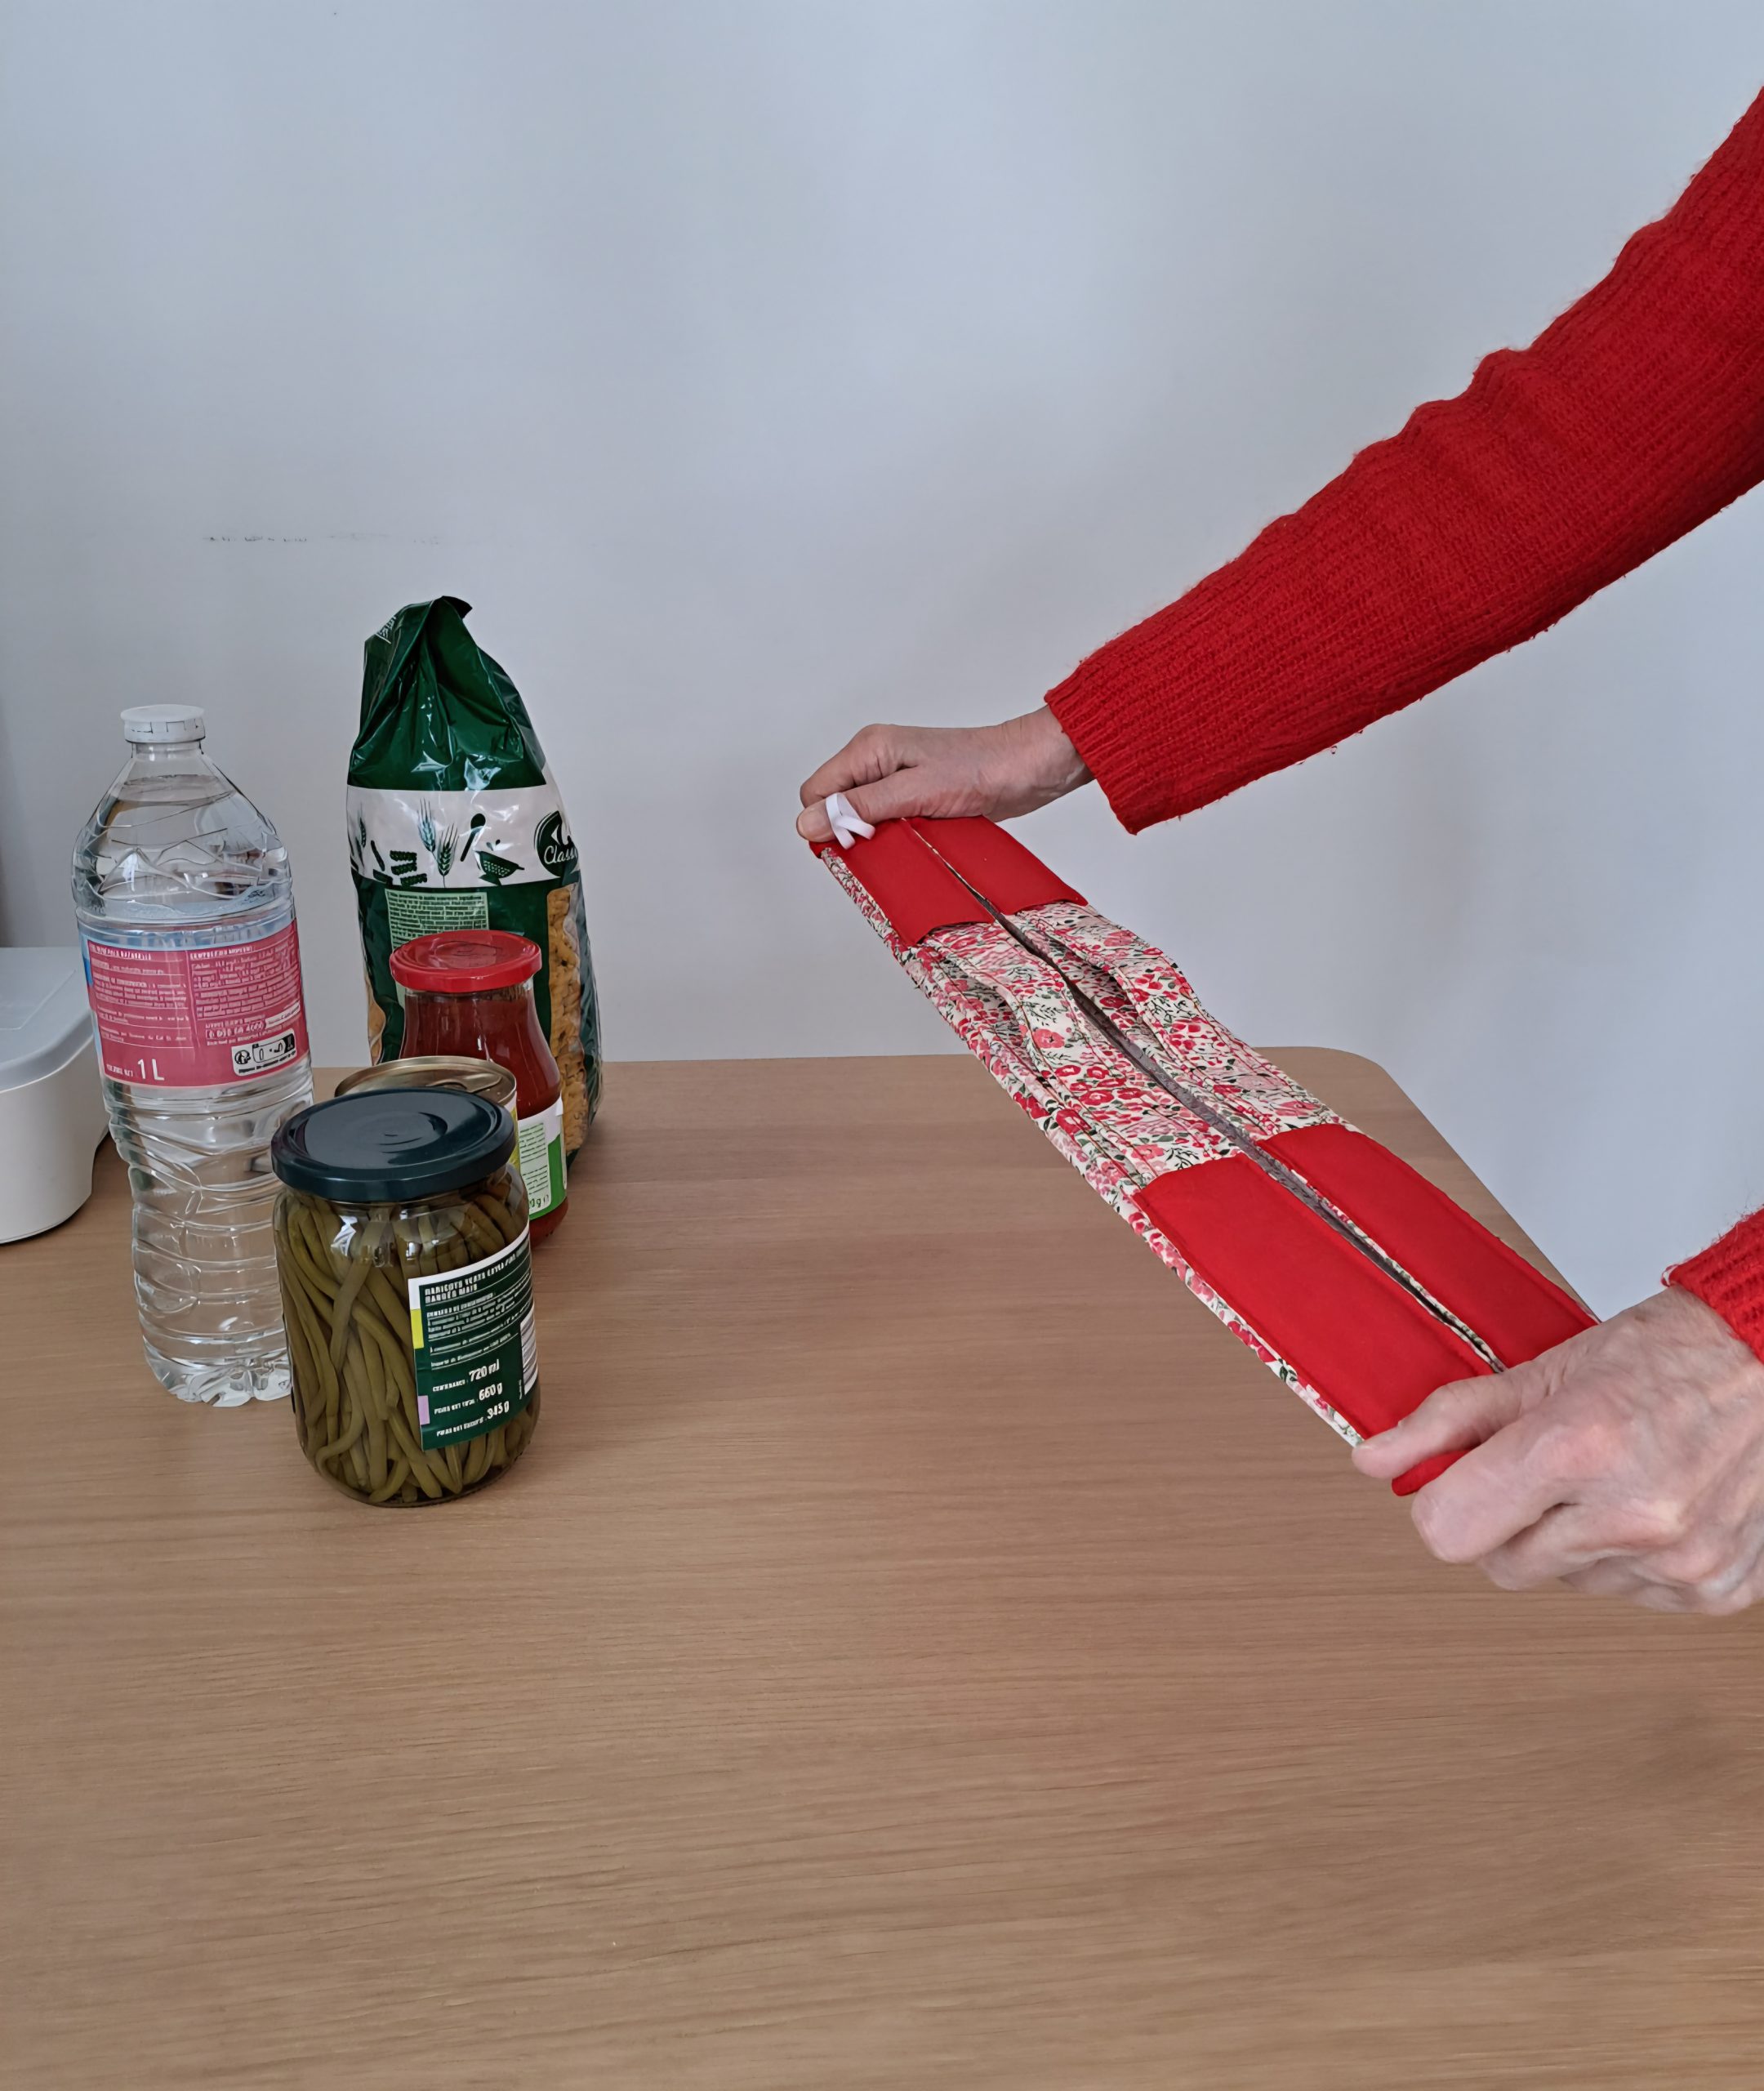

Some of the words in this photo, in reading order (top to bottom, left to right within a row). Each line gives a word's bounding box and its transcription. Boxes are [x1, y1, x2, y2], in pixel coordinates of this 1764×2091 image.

[137, 1059, 146, 1080] 1
[151, 1059, 165, 1081] L
[469, 1366, 488, 1382] 720
[488, 1358, 500, 1375] ml
[479, 1384, 497, 1401] 660
[497, 1382, 503, 1395] g
[487, 1402, 504, 1420] 345
[504, 1400, 510, 1413] g
